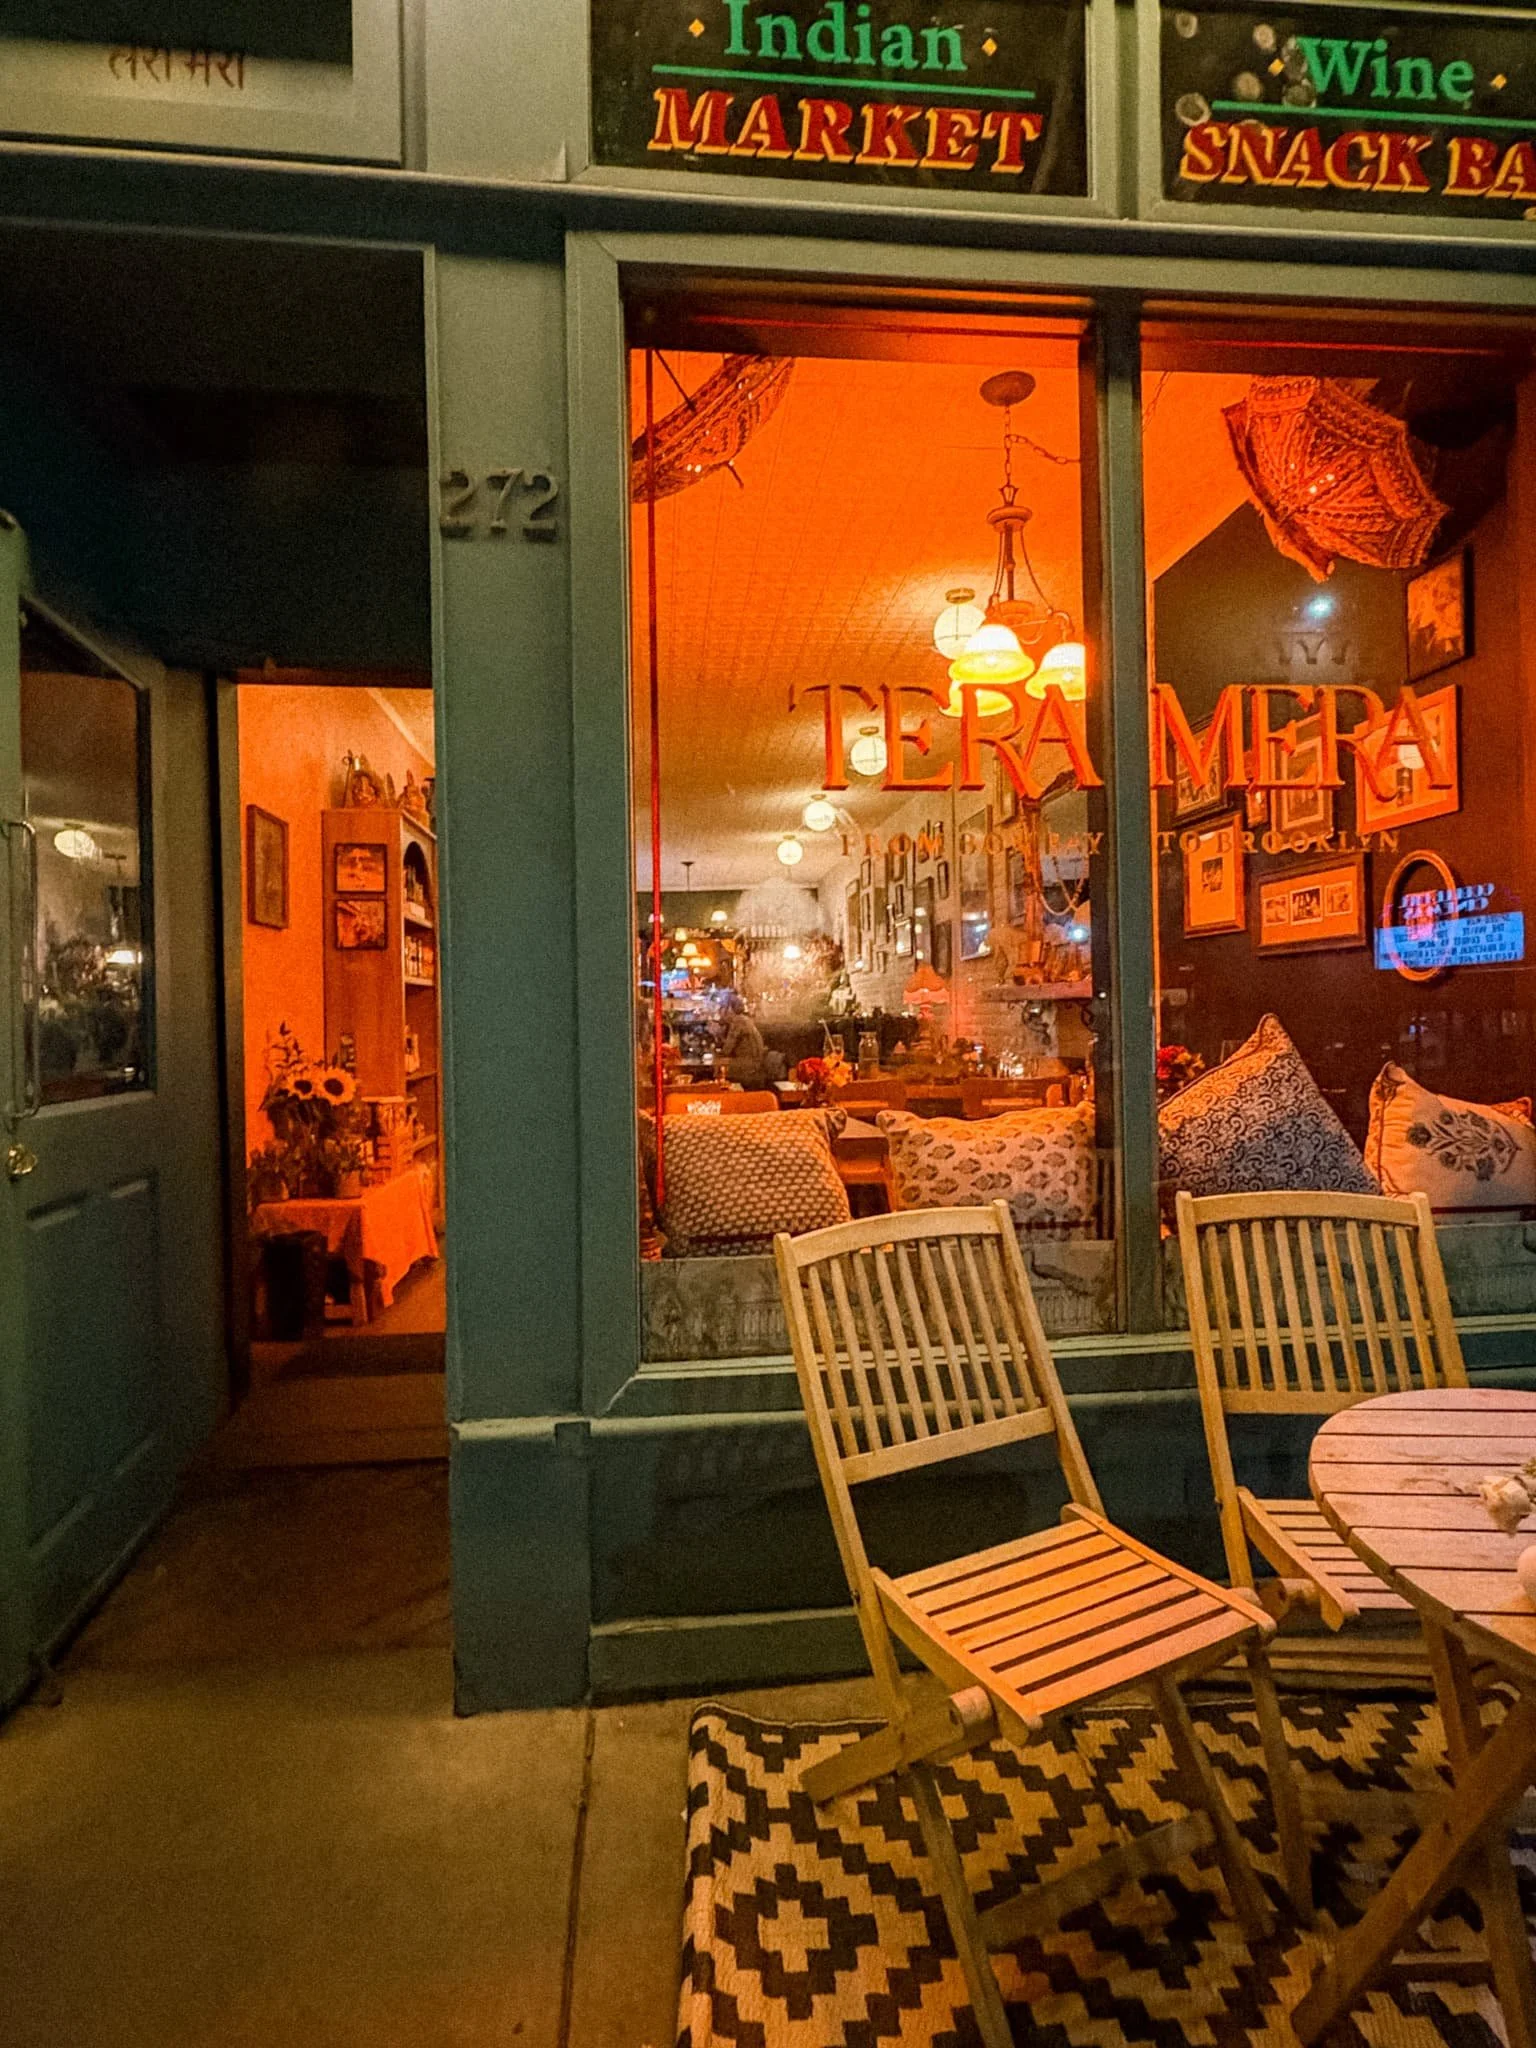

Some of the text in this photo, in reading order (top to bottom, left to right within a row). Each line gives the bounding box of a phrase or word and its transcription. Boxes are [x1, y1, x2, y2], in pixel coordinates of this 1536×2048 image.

[723, 0, 967, 71] Indian
[1296, 36, 1475, 101] Wine
[647, 87, 1043, 174] MARKET
[1180, 121, 1433, 193] SNACK
[440, 468, 560, 543] 272
[789, 683, 1454, 798] TERA MERA
[840, 831, 945, 857] FROM
[1157, 831, 1202, 855] TO
[1217, 830, 1401, 855] BROOKLYN
